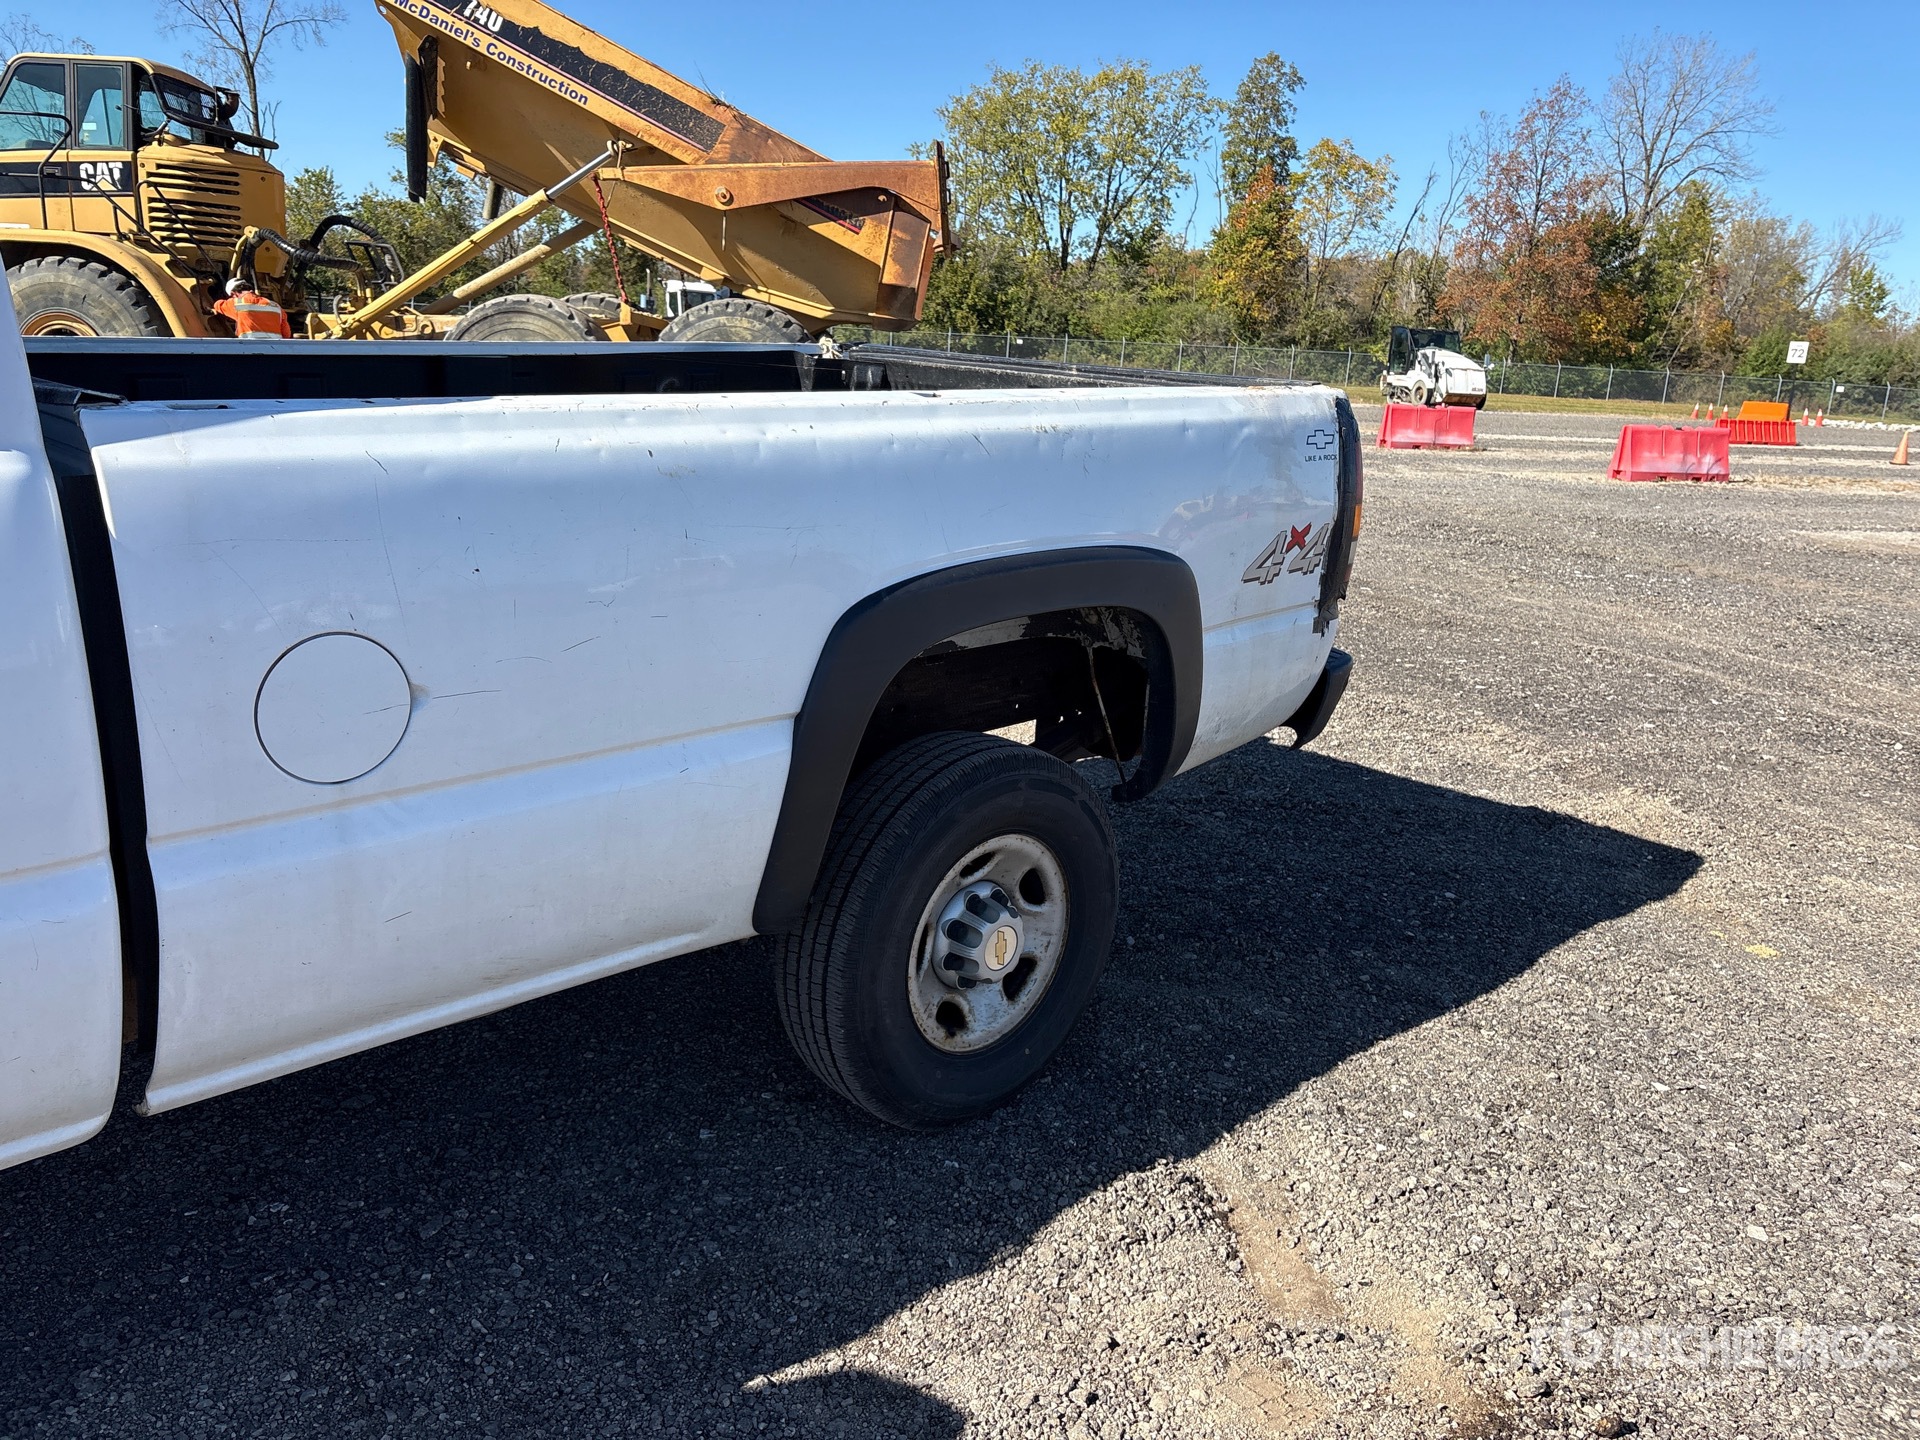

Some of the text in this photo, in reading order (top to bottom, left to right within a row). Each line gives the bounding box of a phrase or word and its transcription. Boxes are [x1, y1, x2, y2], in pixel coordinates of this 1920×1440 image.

[486, 42, 589, 105] Construction
[79, 162, 123, 191] CAT
[1790, 348, 1805, 358] 72
